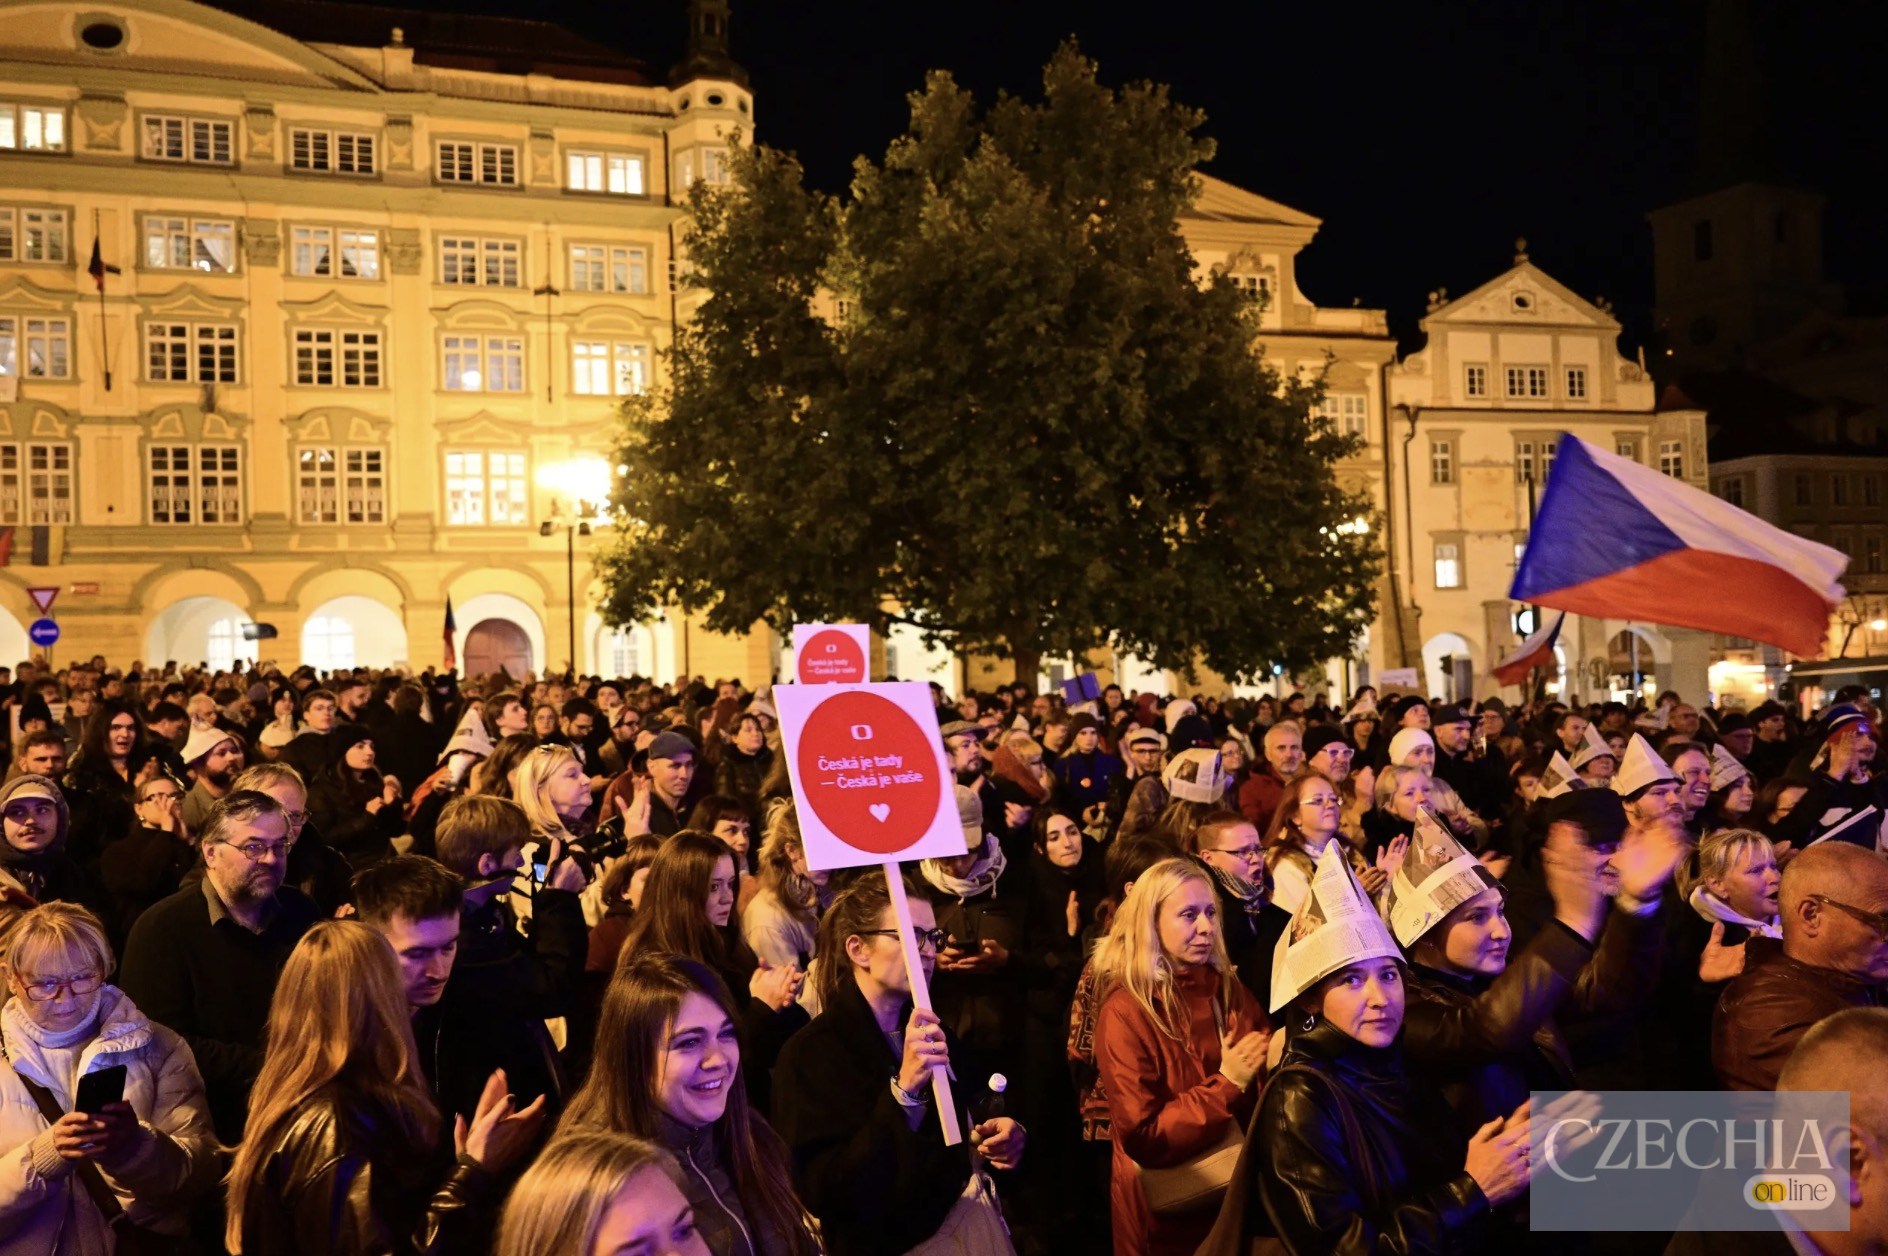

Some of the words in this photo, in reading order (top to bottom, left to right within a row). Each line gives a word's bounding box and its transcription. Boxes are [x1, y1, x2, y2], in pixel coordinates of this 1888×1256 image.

[818, 755, 859, 771] Česká
[859, 755, 873, 771] je
[873, 754, 903, 768] tady
[836, 773, 878, 789] Česká
[878, 773, 892, 788] je
[892, 770, 924, 784] vaše
